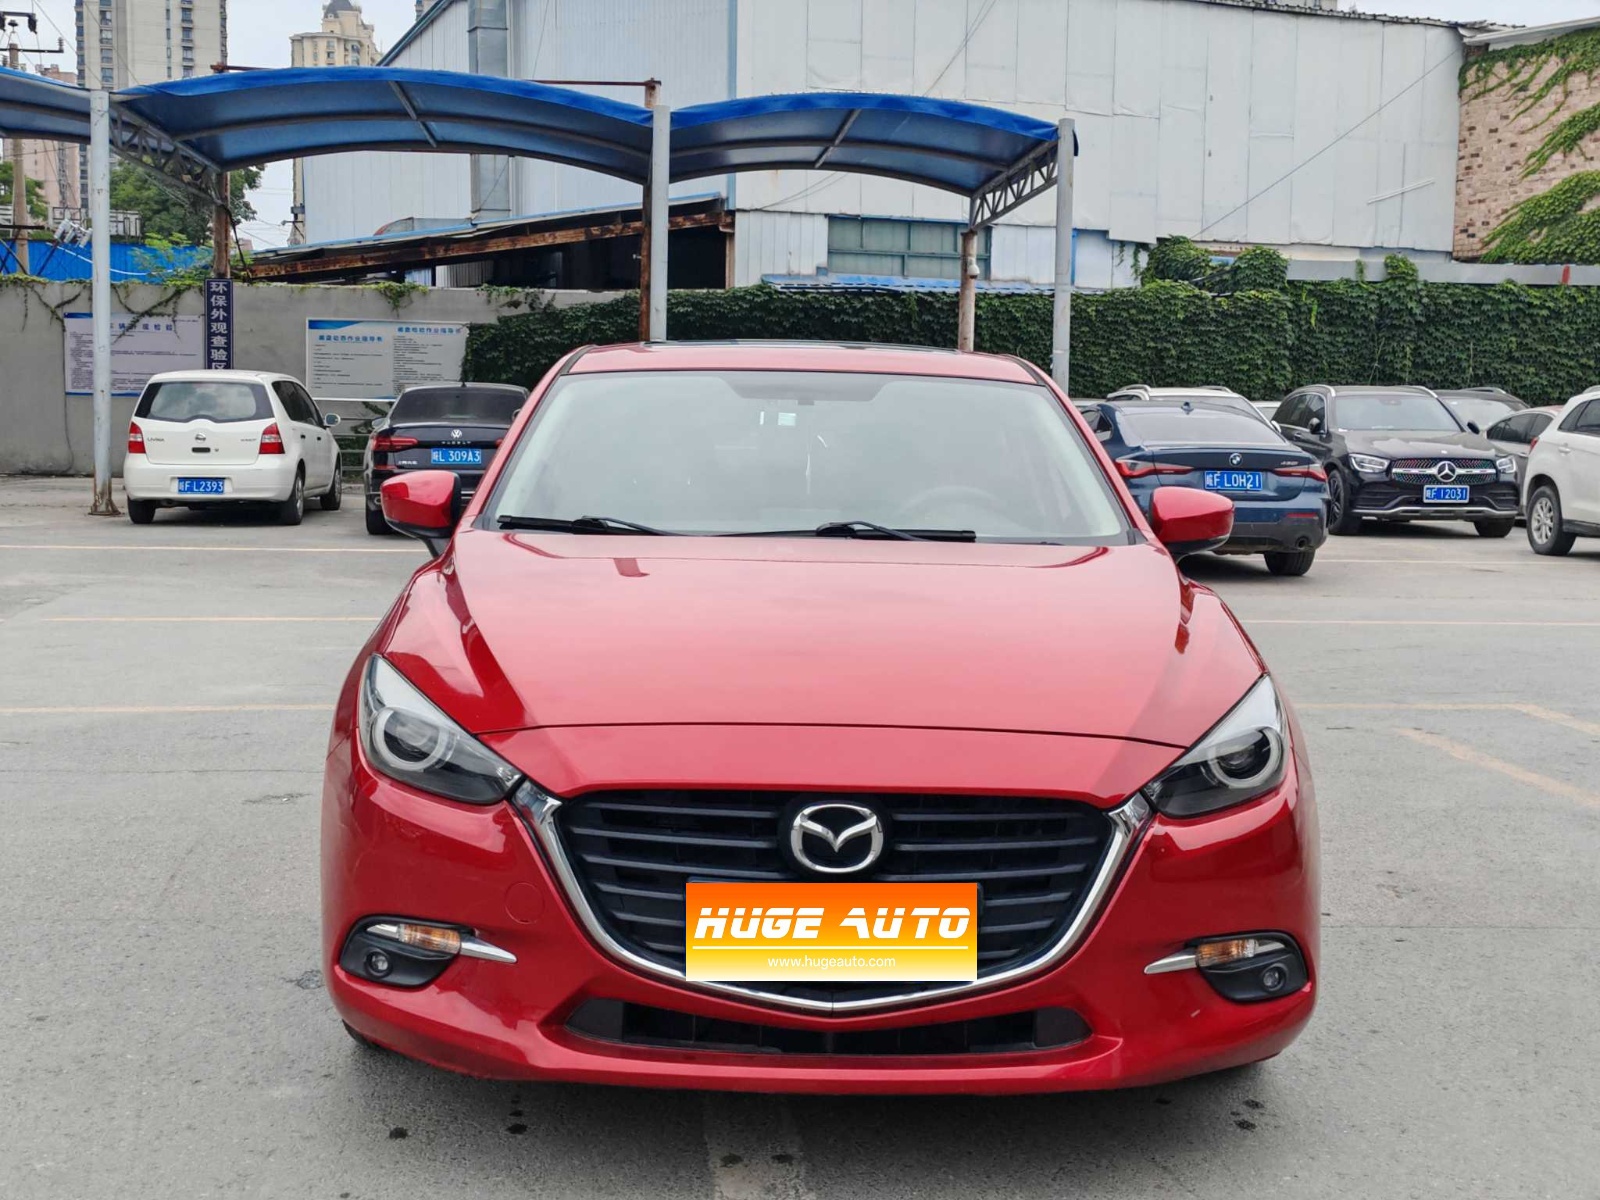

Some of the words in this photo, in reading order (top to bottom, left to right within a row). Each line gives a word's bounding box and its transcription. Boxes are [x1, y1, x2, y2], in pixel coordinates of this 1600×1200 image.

[210, 281, 228, 370] 环保外观查验区
[448, 450, 481, 462] 309A3
[193, 481, 223, 492] L2393
